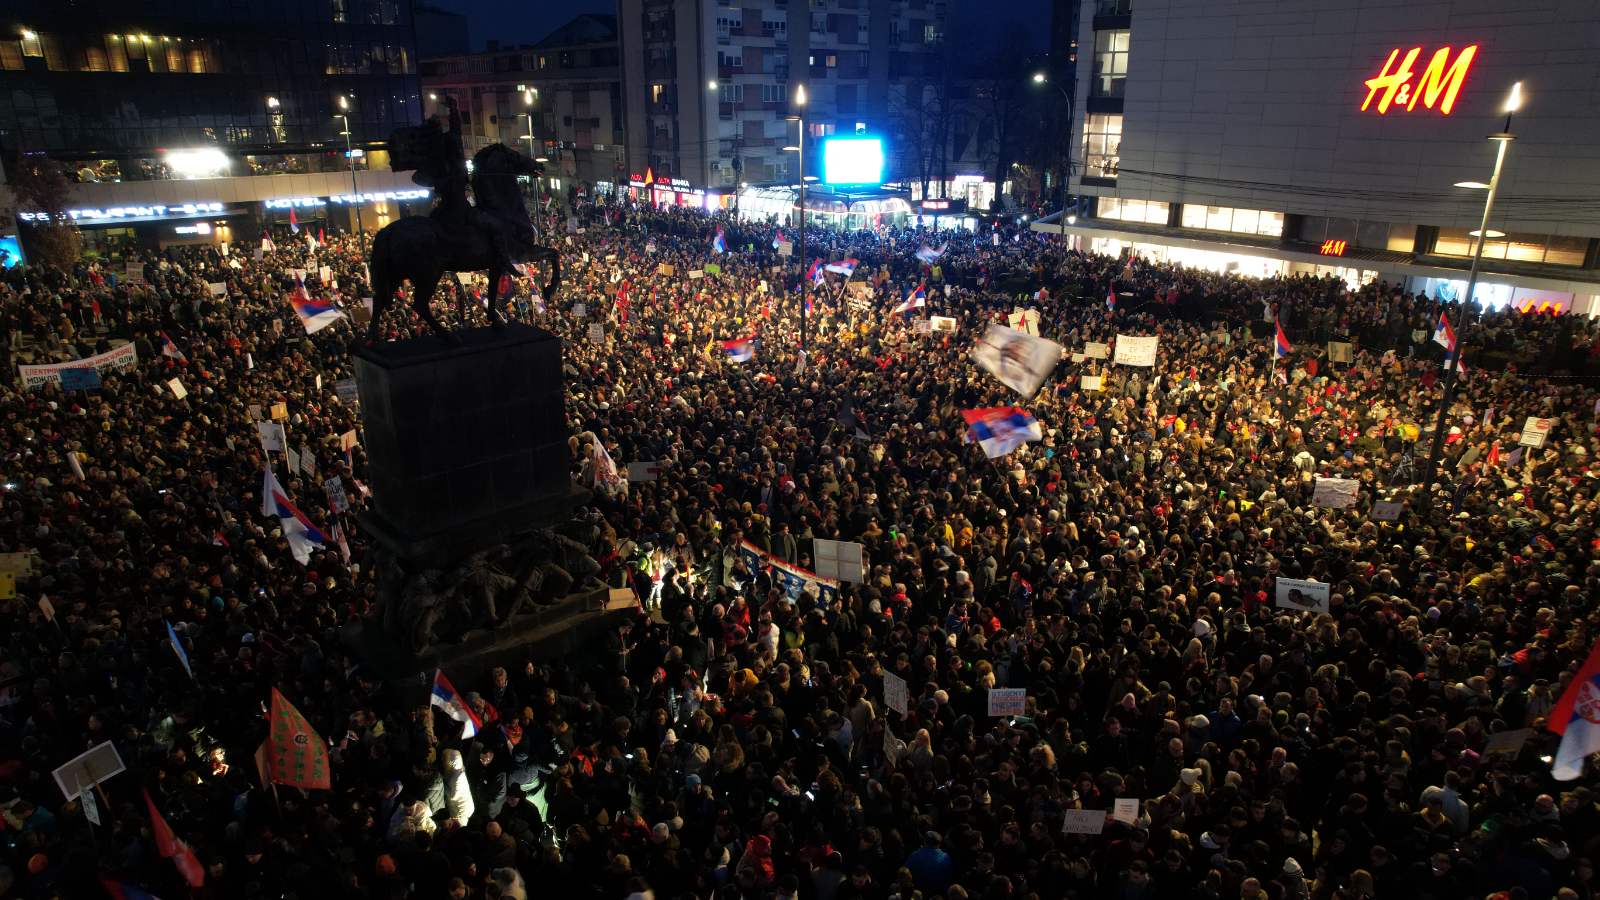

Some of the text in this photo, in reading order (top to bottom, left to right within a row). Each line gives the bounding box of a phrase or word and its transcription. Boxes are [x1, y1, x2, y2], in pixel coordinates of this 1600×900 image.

[1360, 44, 1478, 115] H&M
[657, 176, 690, 187] ALTA BANKA
[265, 189, 430, 209] HOTEL AMBASADOR
[1320, 239, 1346, 256] H&M
